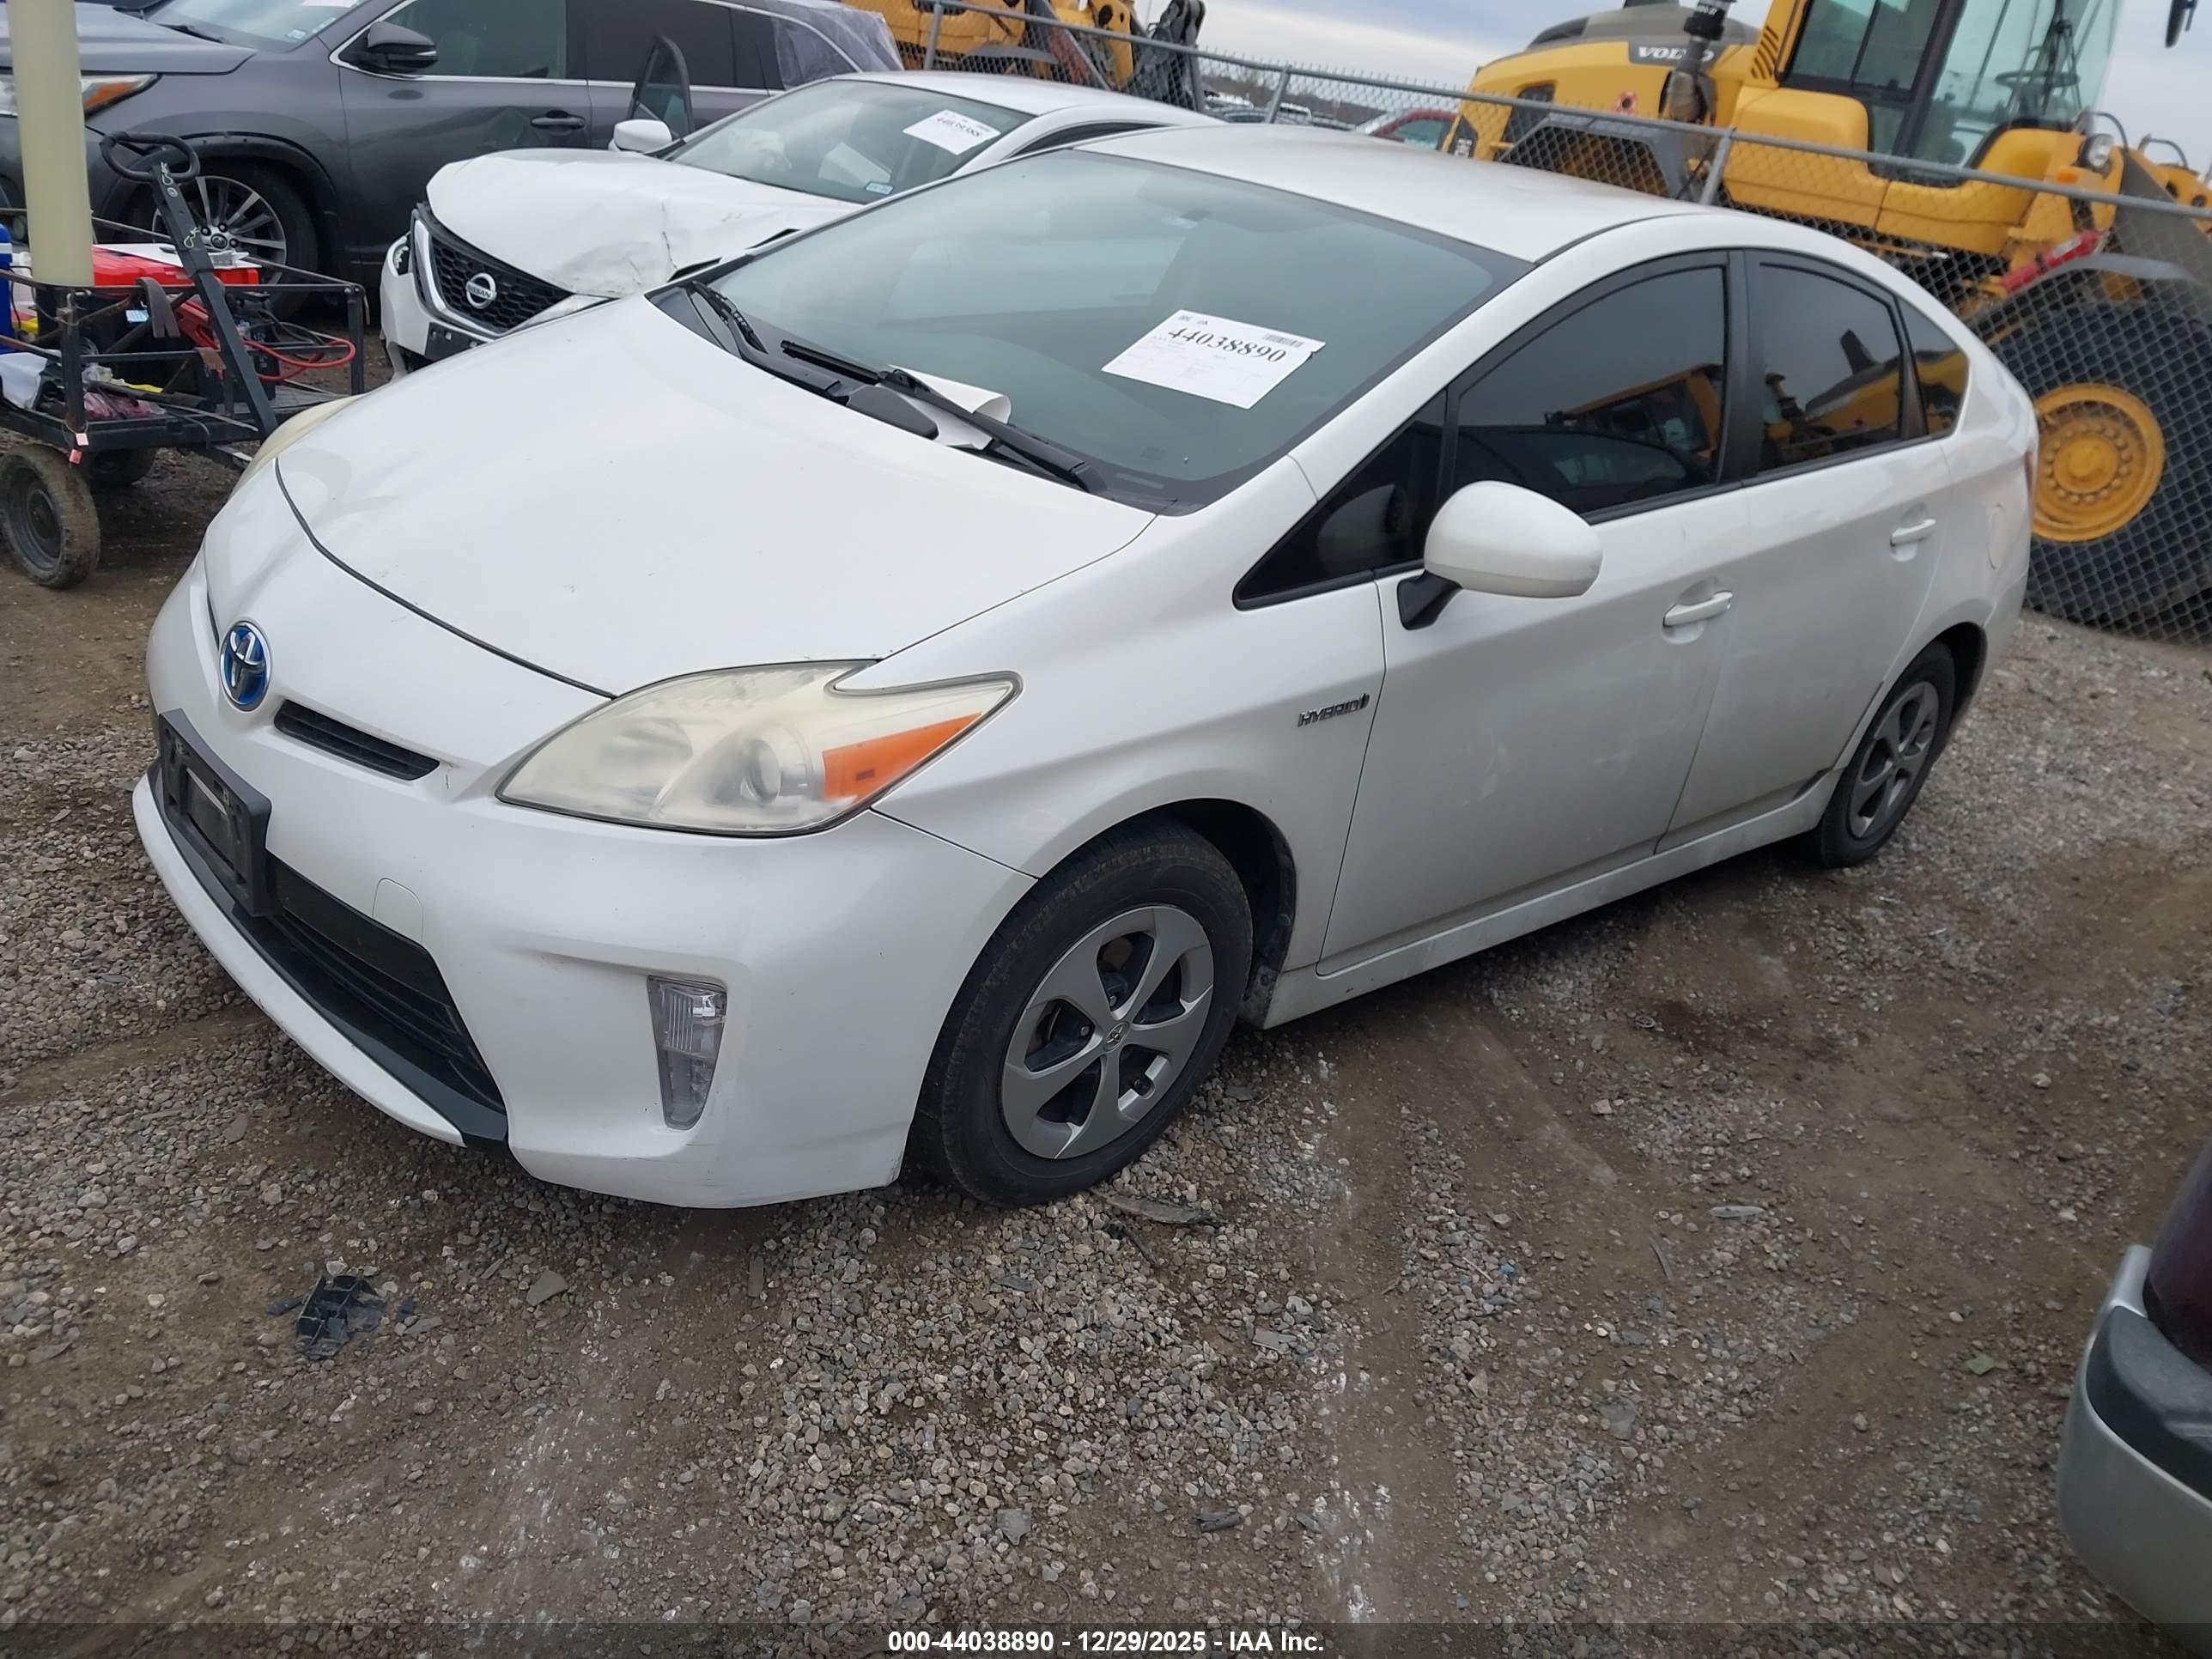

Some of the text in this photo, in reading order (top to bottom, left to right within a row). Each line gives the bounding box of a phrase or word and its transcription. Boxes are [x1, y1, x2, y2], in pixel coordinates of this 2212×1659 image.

[1638, 46, 1715, 62] VOLO
[1168, 328, 1287, 362] 44038890
[1297, 699, 1361, 727] HYBRID
